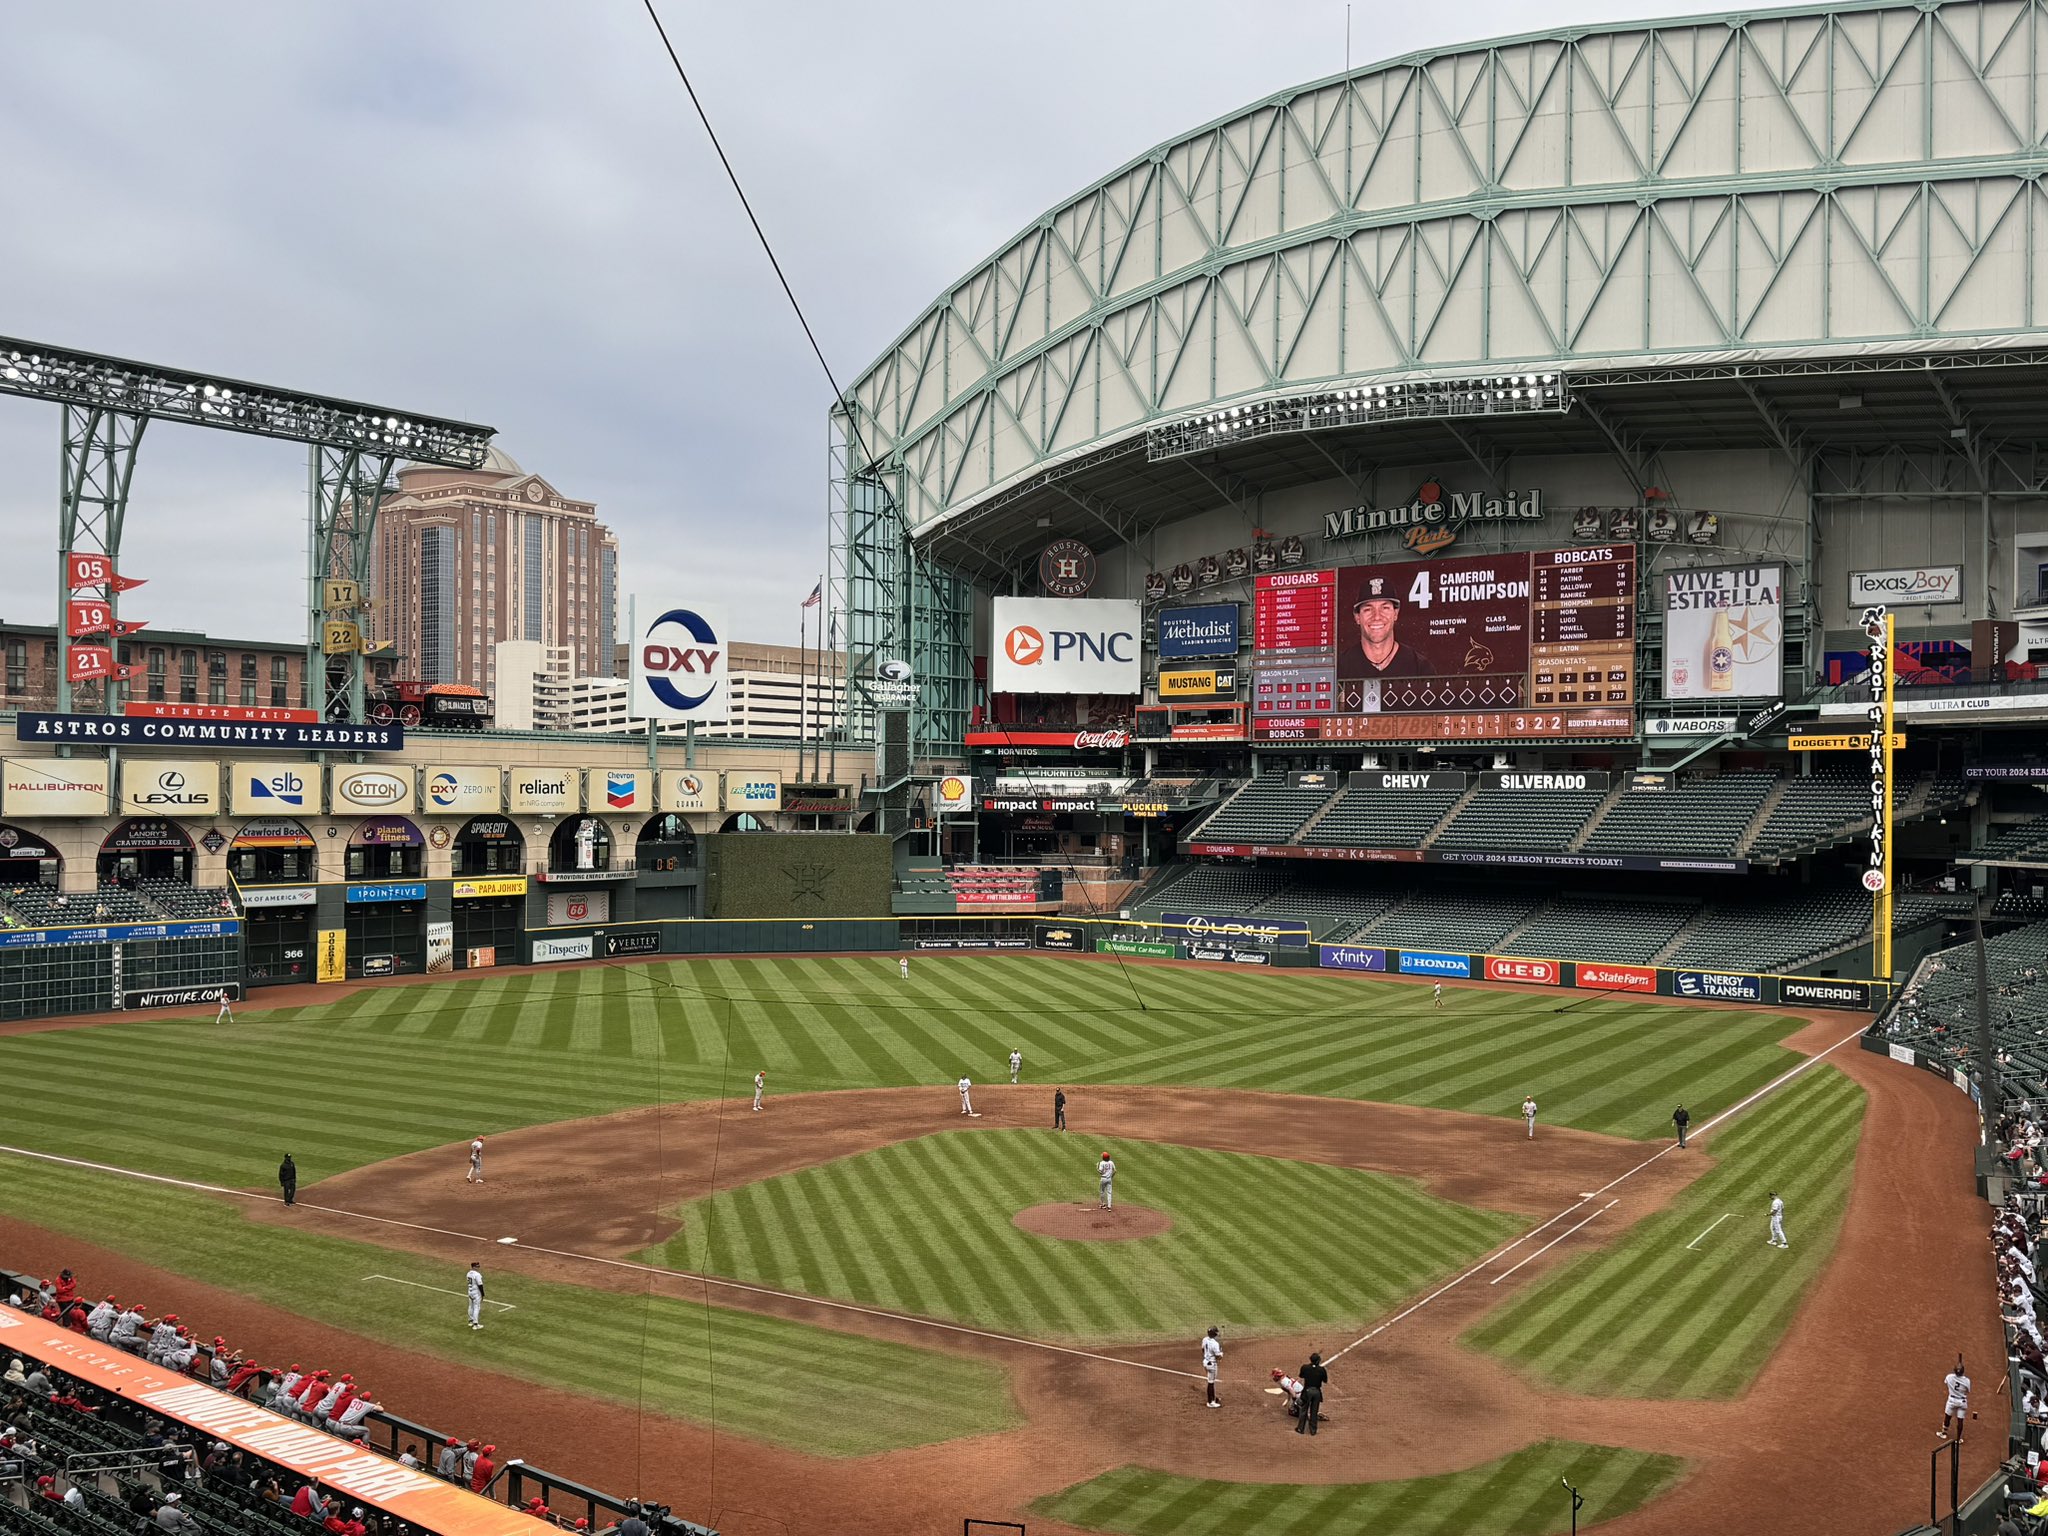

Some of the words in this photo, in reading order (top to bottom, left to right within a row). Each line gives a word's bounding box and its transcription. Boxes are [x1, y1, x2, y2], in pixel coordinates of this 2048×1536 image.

[1323, 500, 1442, 539] Minute
[1450, 489, 1542, 520] Maid
[1406, 526, 1456, 550] Park
[1048, 542, 1090, 558] HOUSTON
[1554, 549, 1613, 564] BOBCATS
[77, 561, 104, 579] 05
[1058, 558, 1078, 578] H
[75, 578, 111, 588] CHAMPIONS
[1271, 573, 1319, 587] COUGARS
[1730, 569, 1760, 589] TU
[1856, 574, 1908, 593] Texas
[1910, 571, 1954, 595] Bay
[1049, 580, 1087, 594] ASTROS
[1408, 571, 1433, 609] 4
[1440, 570, 1494, 585] CAMERON
[1439, 581, 1529, 603] THOMPSON
[1560, 583, 1593, 591] GALLOWAY
[333, 587, 352, 602] 17
[79, 609, 103, 625] 19
[1430, 618, 1467, 626] HOMETOWN
[75, 624, 110, 634] CHAMPIONS
[1164, 620, 1232, 640] Methodist
[332, 631, 351, 644] 22
[1049, 631, 1133, 663] PNC
[78, 653, 101, 669] 21
[643, 645, 720, 675] OXY
[1566, 657, 1587, 665] STATS
[73, 669, 106, 679] CHAMPIONS
[1260, 670, 1282, 678] SEASON
[1283, 669, 1299, 677] STATS
[1870, 645, 1885, 701] ROOT
[869, 681, 921, 694] Gallagher
[1168, 677, 1211, 690] MUSTANG
[1216, 676, 1234, 688] CAT
[1930, 701, 1960, 711] ULTRA
[1966, 699, 1990, 709] CLUB
[155, 706, 230, 718] MINUTE
[245, 710, 291, 720] MAID
[1870, 707, 1882, 724] 4
[1268, 718, 1305, 728] COUGARS
[1515, 717, 1525, 731] 3
[1534, 717, 1543, 731] 2
[1551, 716, 1561, 731] 2
[1672, 720, 1726, 731] NABORS
[35, 721, 130, 737] ASTROS
[143, 725, 287, 741] COMMUNITY
[298, 729, 389, 744] LEADERS
[1269, 729, 1304, 739] BOBCATS
[1793, 739, 1846, 748] DOGGETT
[998, 748, 1038, 757] HORNITOS
[1869, 729, 1884, 774] THA
[608, 771, 635, 780] Chevron
[1041, 769, 1086, 778] HORNITOS
[1966, 768, 1984, 777] GET
[1984, 768, 2007, 777] YOUR
[2008, 768, 2029, 777] 2024
[8, 782, 104, 792] HALLIBURTON
[272, 772, 303, 793] slb
[519, 780, 566, 795] reliant
[1382, 774, 1431, 788] CHEVY
[1500, 774, 1586, 790] SILVERADO
[349, 780, 397, 799] COTTON
[430, 785, 458, 795] OXY
[463, 785, 482, 794] ZERO
[731, 787, 772, 796] FREEPORT
[745, 782, 776, 800] LNG
[133, 793, 209, 805] LEXUS
[540, 801, 566, 810] company
[993, 798, 1038, 812] impact
[1051, 798, 1096, 813] impact
[1123, 803, 1169, 812] PLUCKERS
[470, 822, 493, 834] SPACE
[493, 822, 509, 834] CITY
[1870, 780, 1885, 867] CHIKIN
[129, 831, 168, 839] LANDRY'S
[242, 828, 281, 837] Crawford
[377, 826, 405, 836] planet
[380, 833, 411, 842] fitness
[1206, 845, 1235, 854] COUGARS
[1442, 853, 1459, 861] GET
[1461, 854, 1485, 863] YOUR
[1486, 855, 1506, 863] 2024
[1507, 855, 1543, 865] SEASON
[1544, 857, 1585, 866] TICKETS
[1587, 858, 1623, 868] TODAY!
[556, 873, 585, 881] PROVIDING
[358, 887, 417, 899] 1POINTFIVE
[478, 884, 497, 895] PAPA
[497, 883, 522, 893] JOHN'S
[264, 894, 297, 902] AMERICA
[570, 904, 584, 916] 66
[428, 938, 451, 948] WM
[618, 937, 657, 947] VERITEX
[1257, 936, 1274, 944] 370
[284, 950, 303, 960] 366
[548, 942, 590, 956] Insperity
[1112, 943, 1137, 953] National
[1138, 946, 1150, 954] Car
[1150, 947, 1167, 956] Rental
[1331, 949, 1374, 968] xfinity
[1413, 958, 1468, 971] HONDA
[1703, 974, 1744, 987] ENERGY
[140, 988, 224, 1007] NITTOTIRE.COM
[1703, 985, 1756, 999] TRANSFER
[1786, 985, 1862, 1002] POWERADE
[43, 1337, 133, 1377] WELCOME
[133, 1375, 165, 1390] TO
[350, 1399, 364, 1412] 30
[140, 1384, 275, 1435] MINUTE
[232, 1419, 354, 1466] MAID
[320, 1454, 444, 1502] PARK
